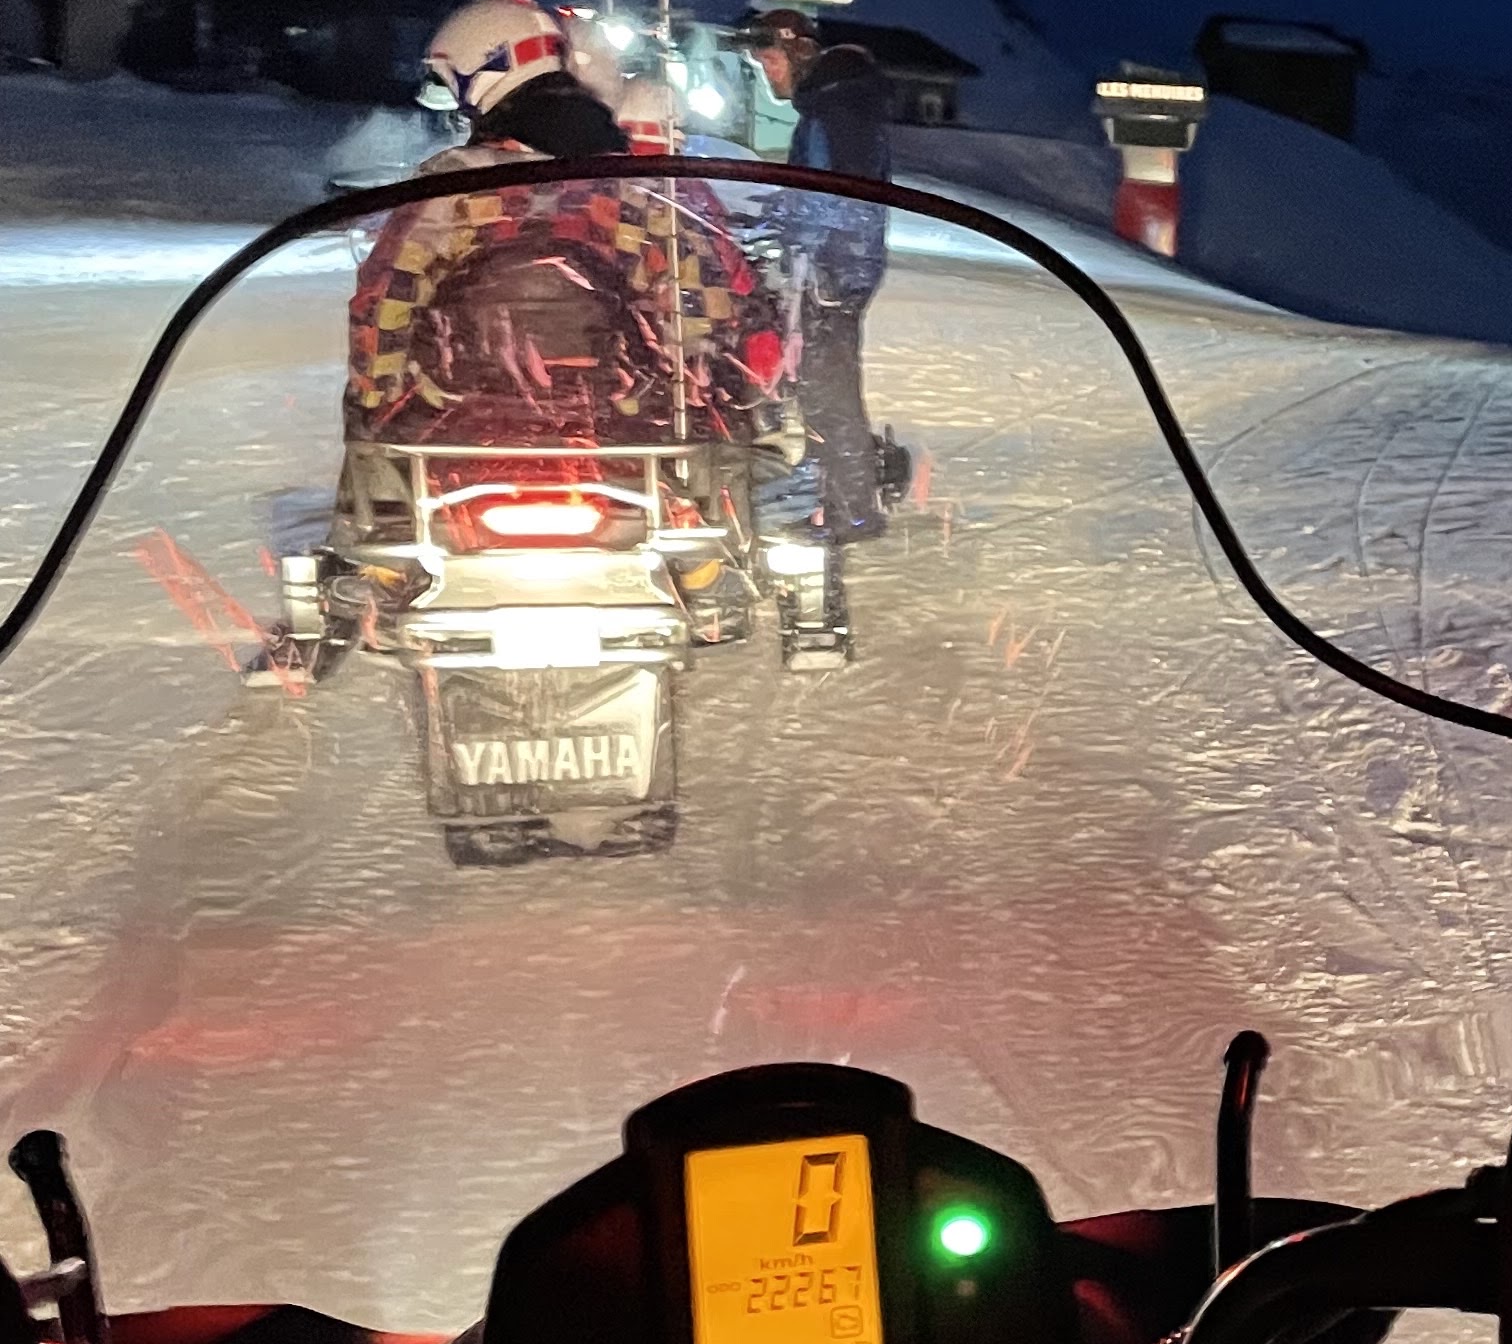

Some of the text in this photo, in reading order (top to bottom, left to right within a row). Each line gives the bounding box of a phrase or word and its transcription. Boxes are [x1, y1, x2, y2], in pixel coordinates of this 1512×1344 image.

[452, 735, 643, 785] YAMAHA
[792, 1151, 847, 1247] 0
[759, 1254, 814, 1271] km/h
[746, 1265, 862, 1314] 22267
